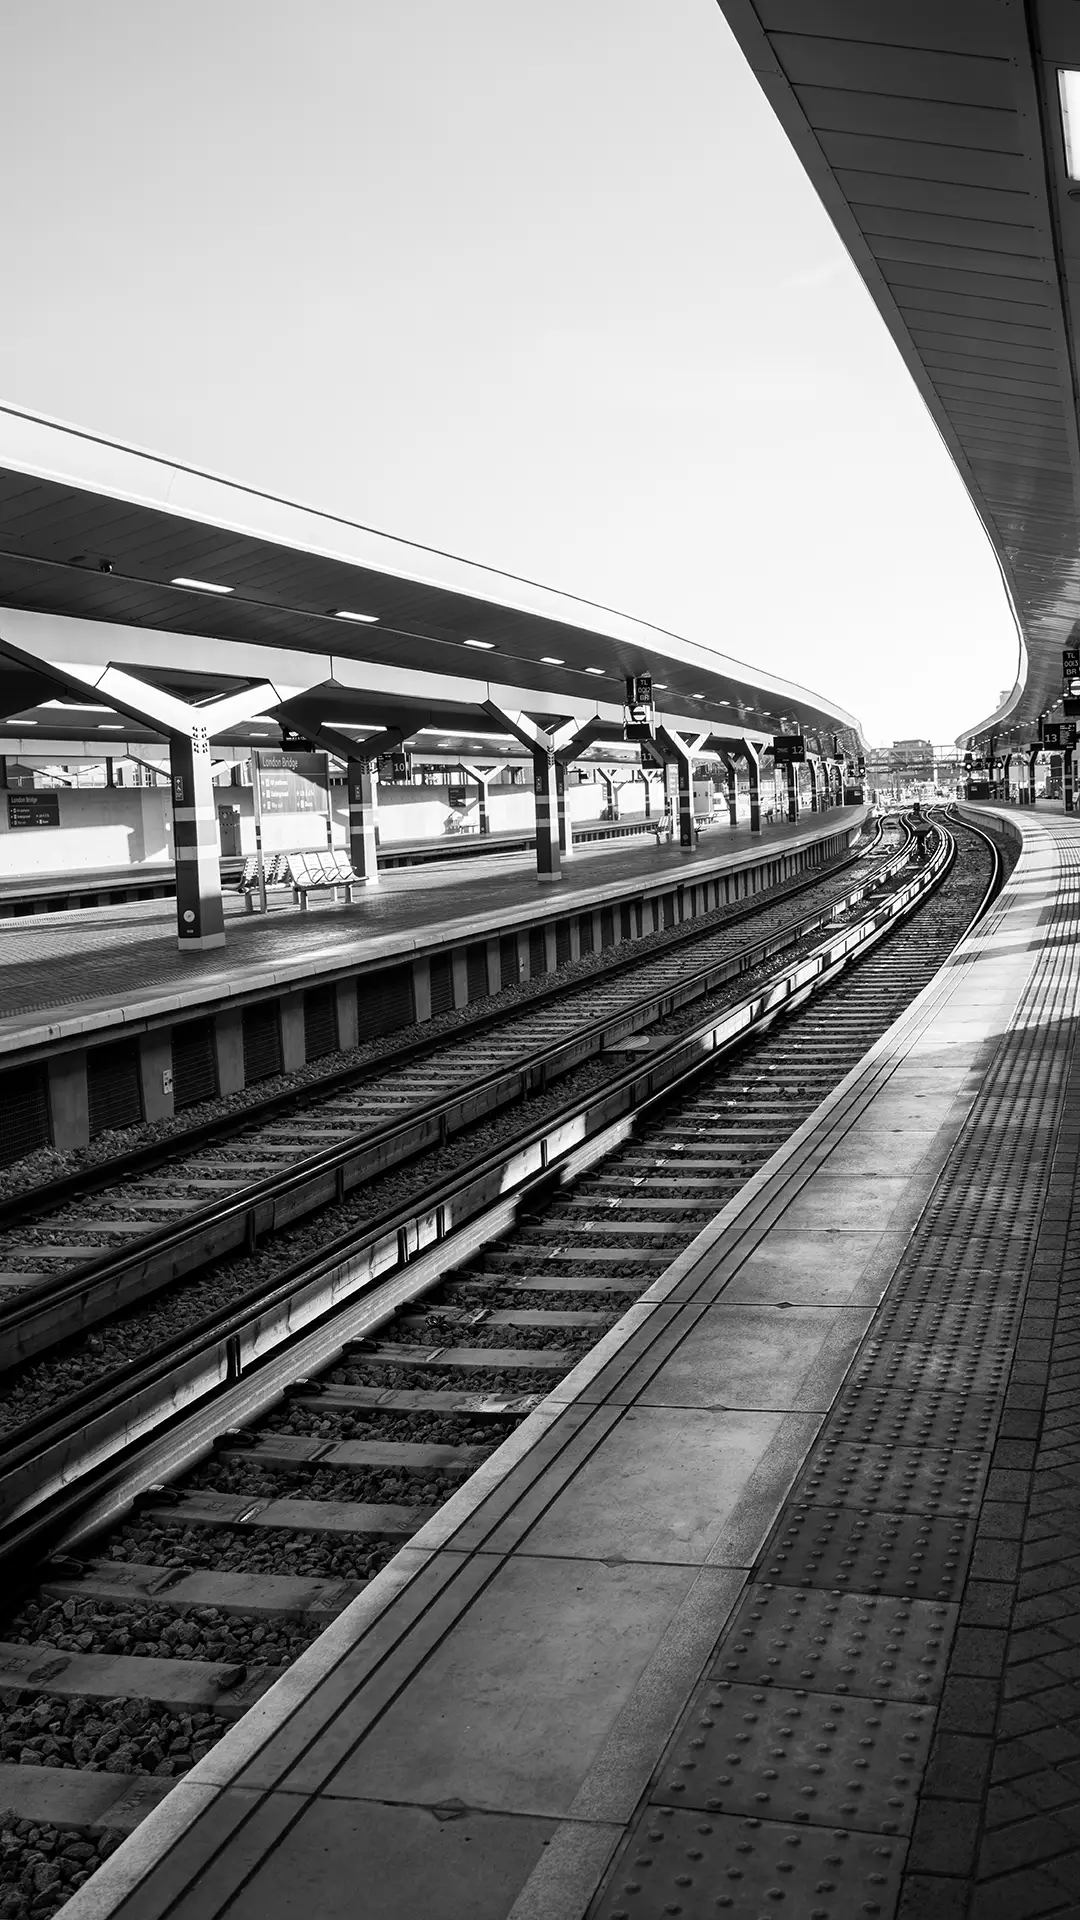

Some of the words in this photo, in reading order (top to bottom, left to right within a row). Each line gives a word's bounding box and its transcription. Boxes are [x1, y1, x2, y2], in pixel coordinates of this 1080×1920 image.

[1045, 733, 1058, 743] 13
[791, 745, 804, 755] 12
[642, 752, 654, 761] 11
[262, 756, 282, 768] London
[282, 756, 298, 770] Bridge
[394, 762, 405, 772] 10
